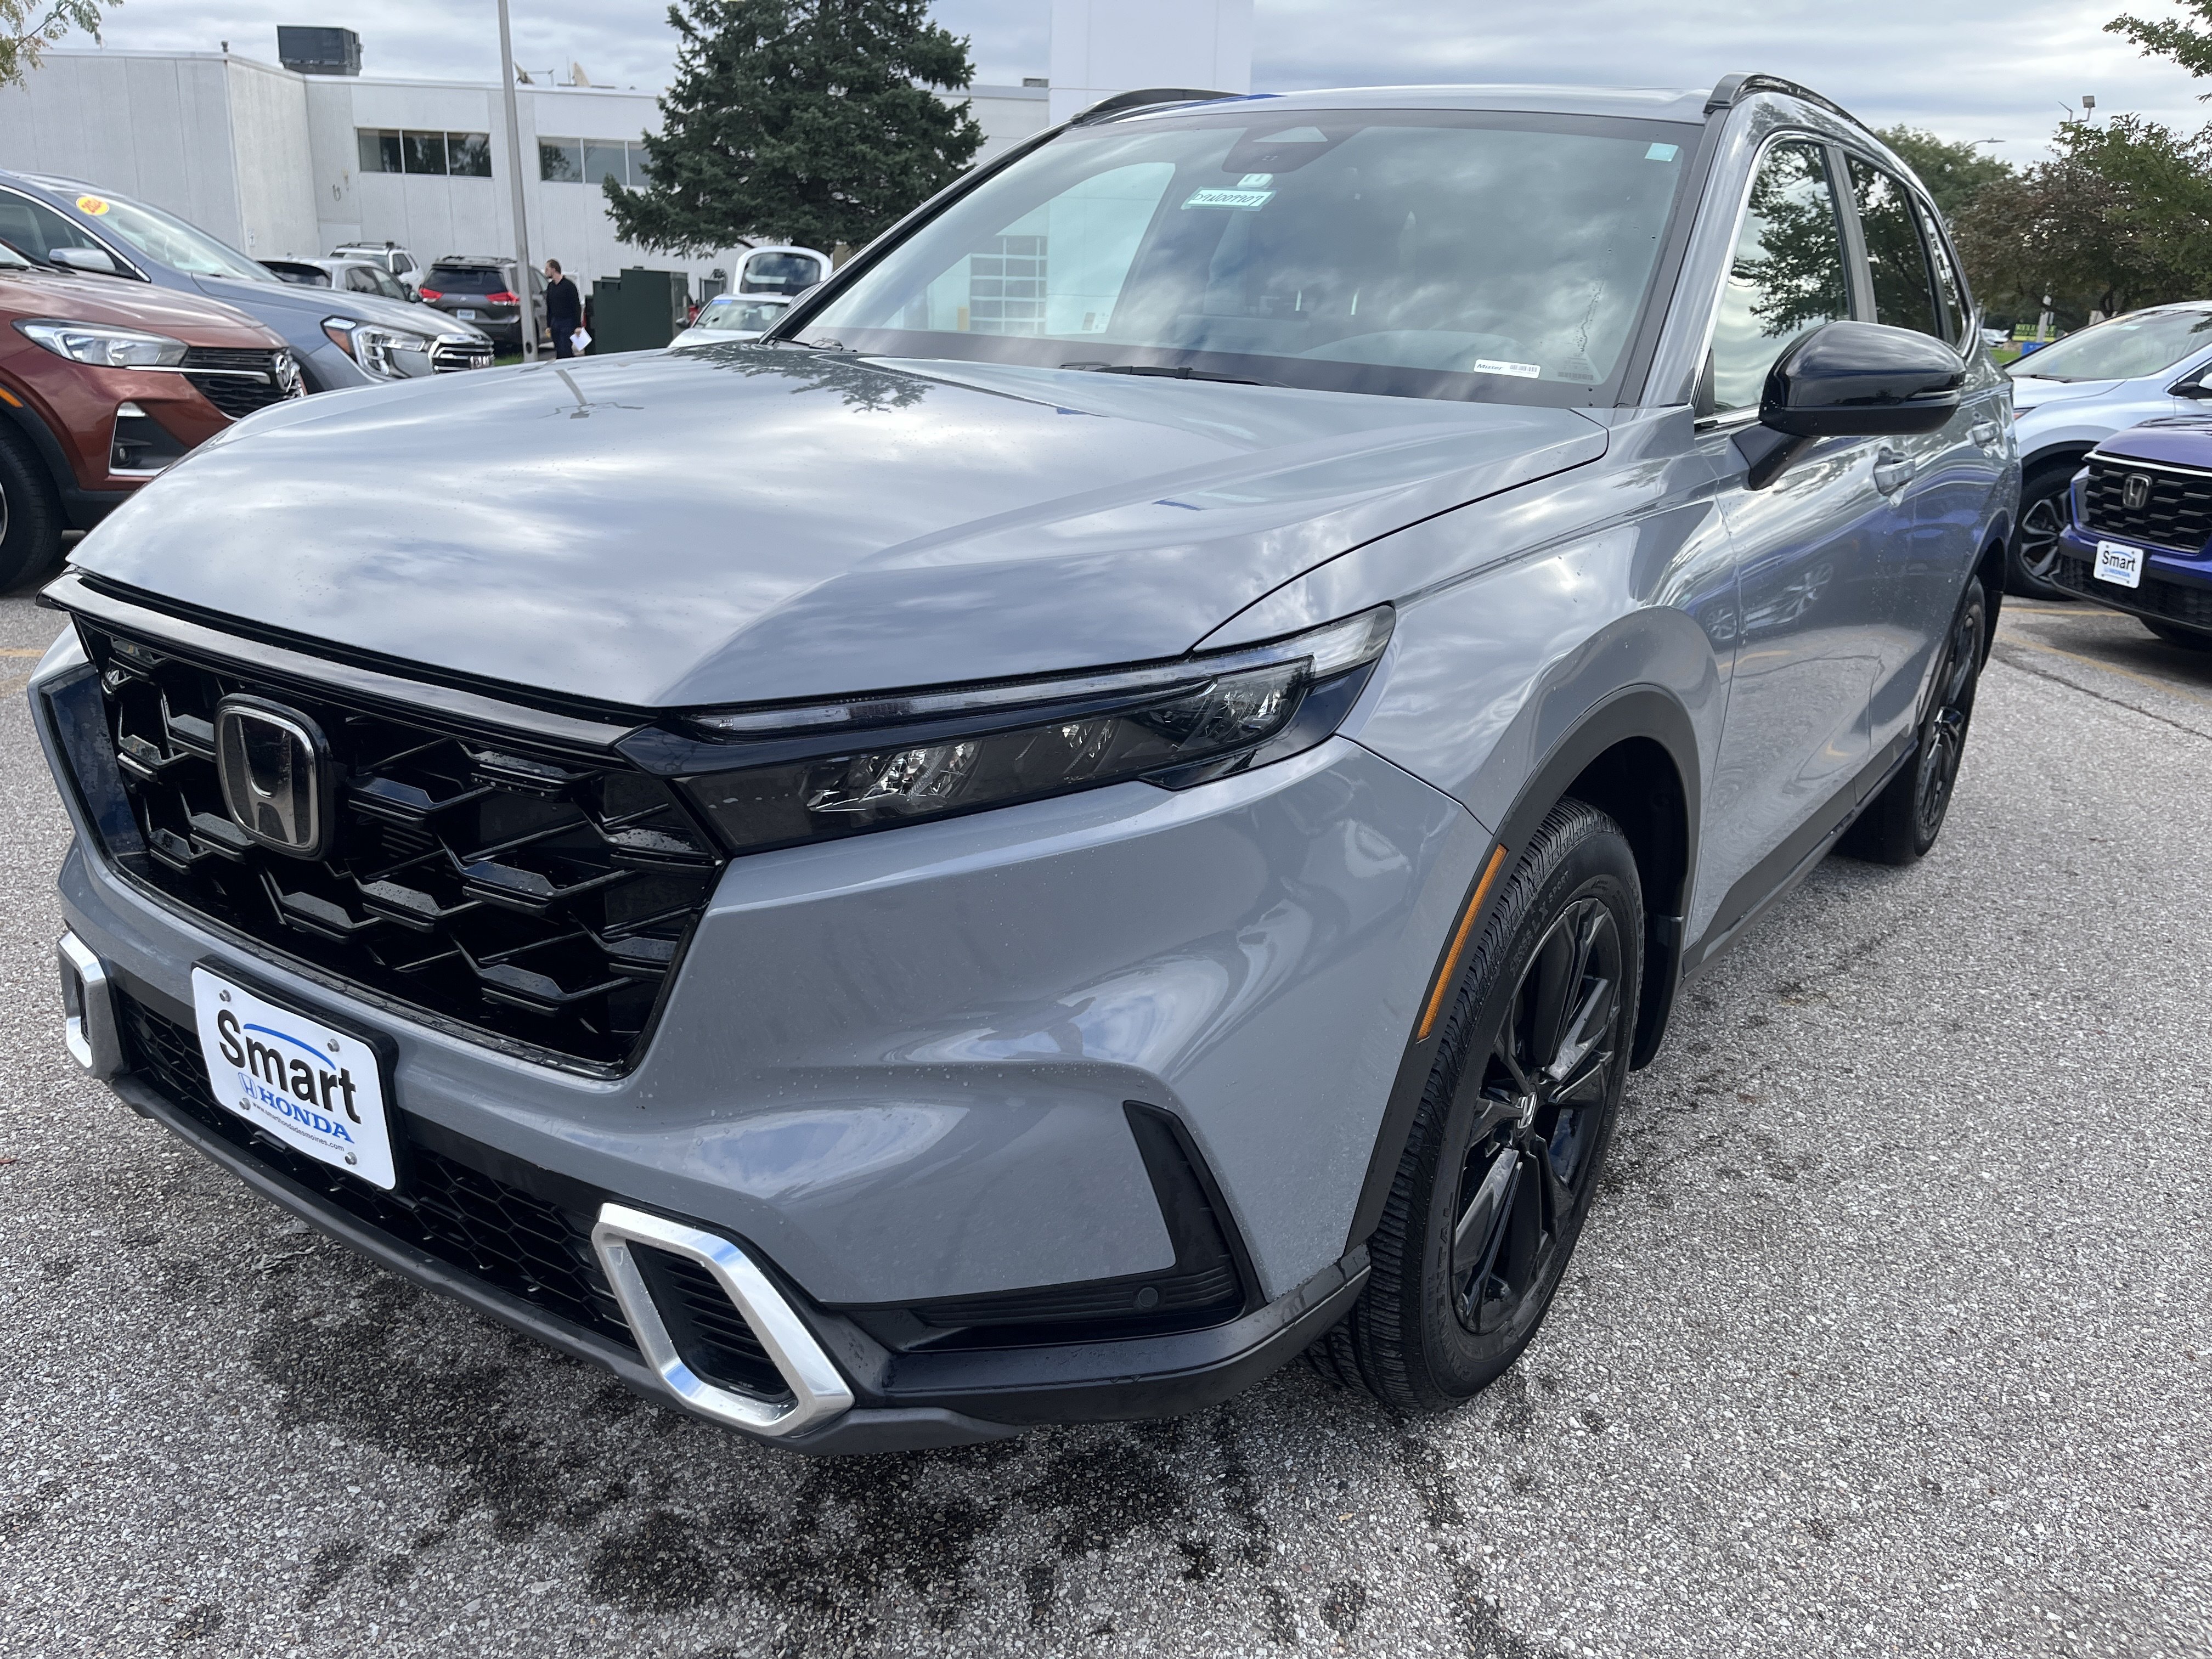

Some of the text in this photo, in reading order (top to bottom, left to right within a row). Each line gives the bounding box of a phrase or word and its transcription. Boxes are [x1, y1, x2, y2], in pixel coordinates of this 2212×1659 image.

[2102, 550, 2136, 571] Smart
[1549, 870, 1568, 902] SPORT
[217, 1009, 362, 1124] Smart
[257, 1085, 354, 1144] HONDA
